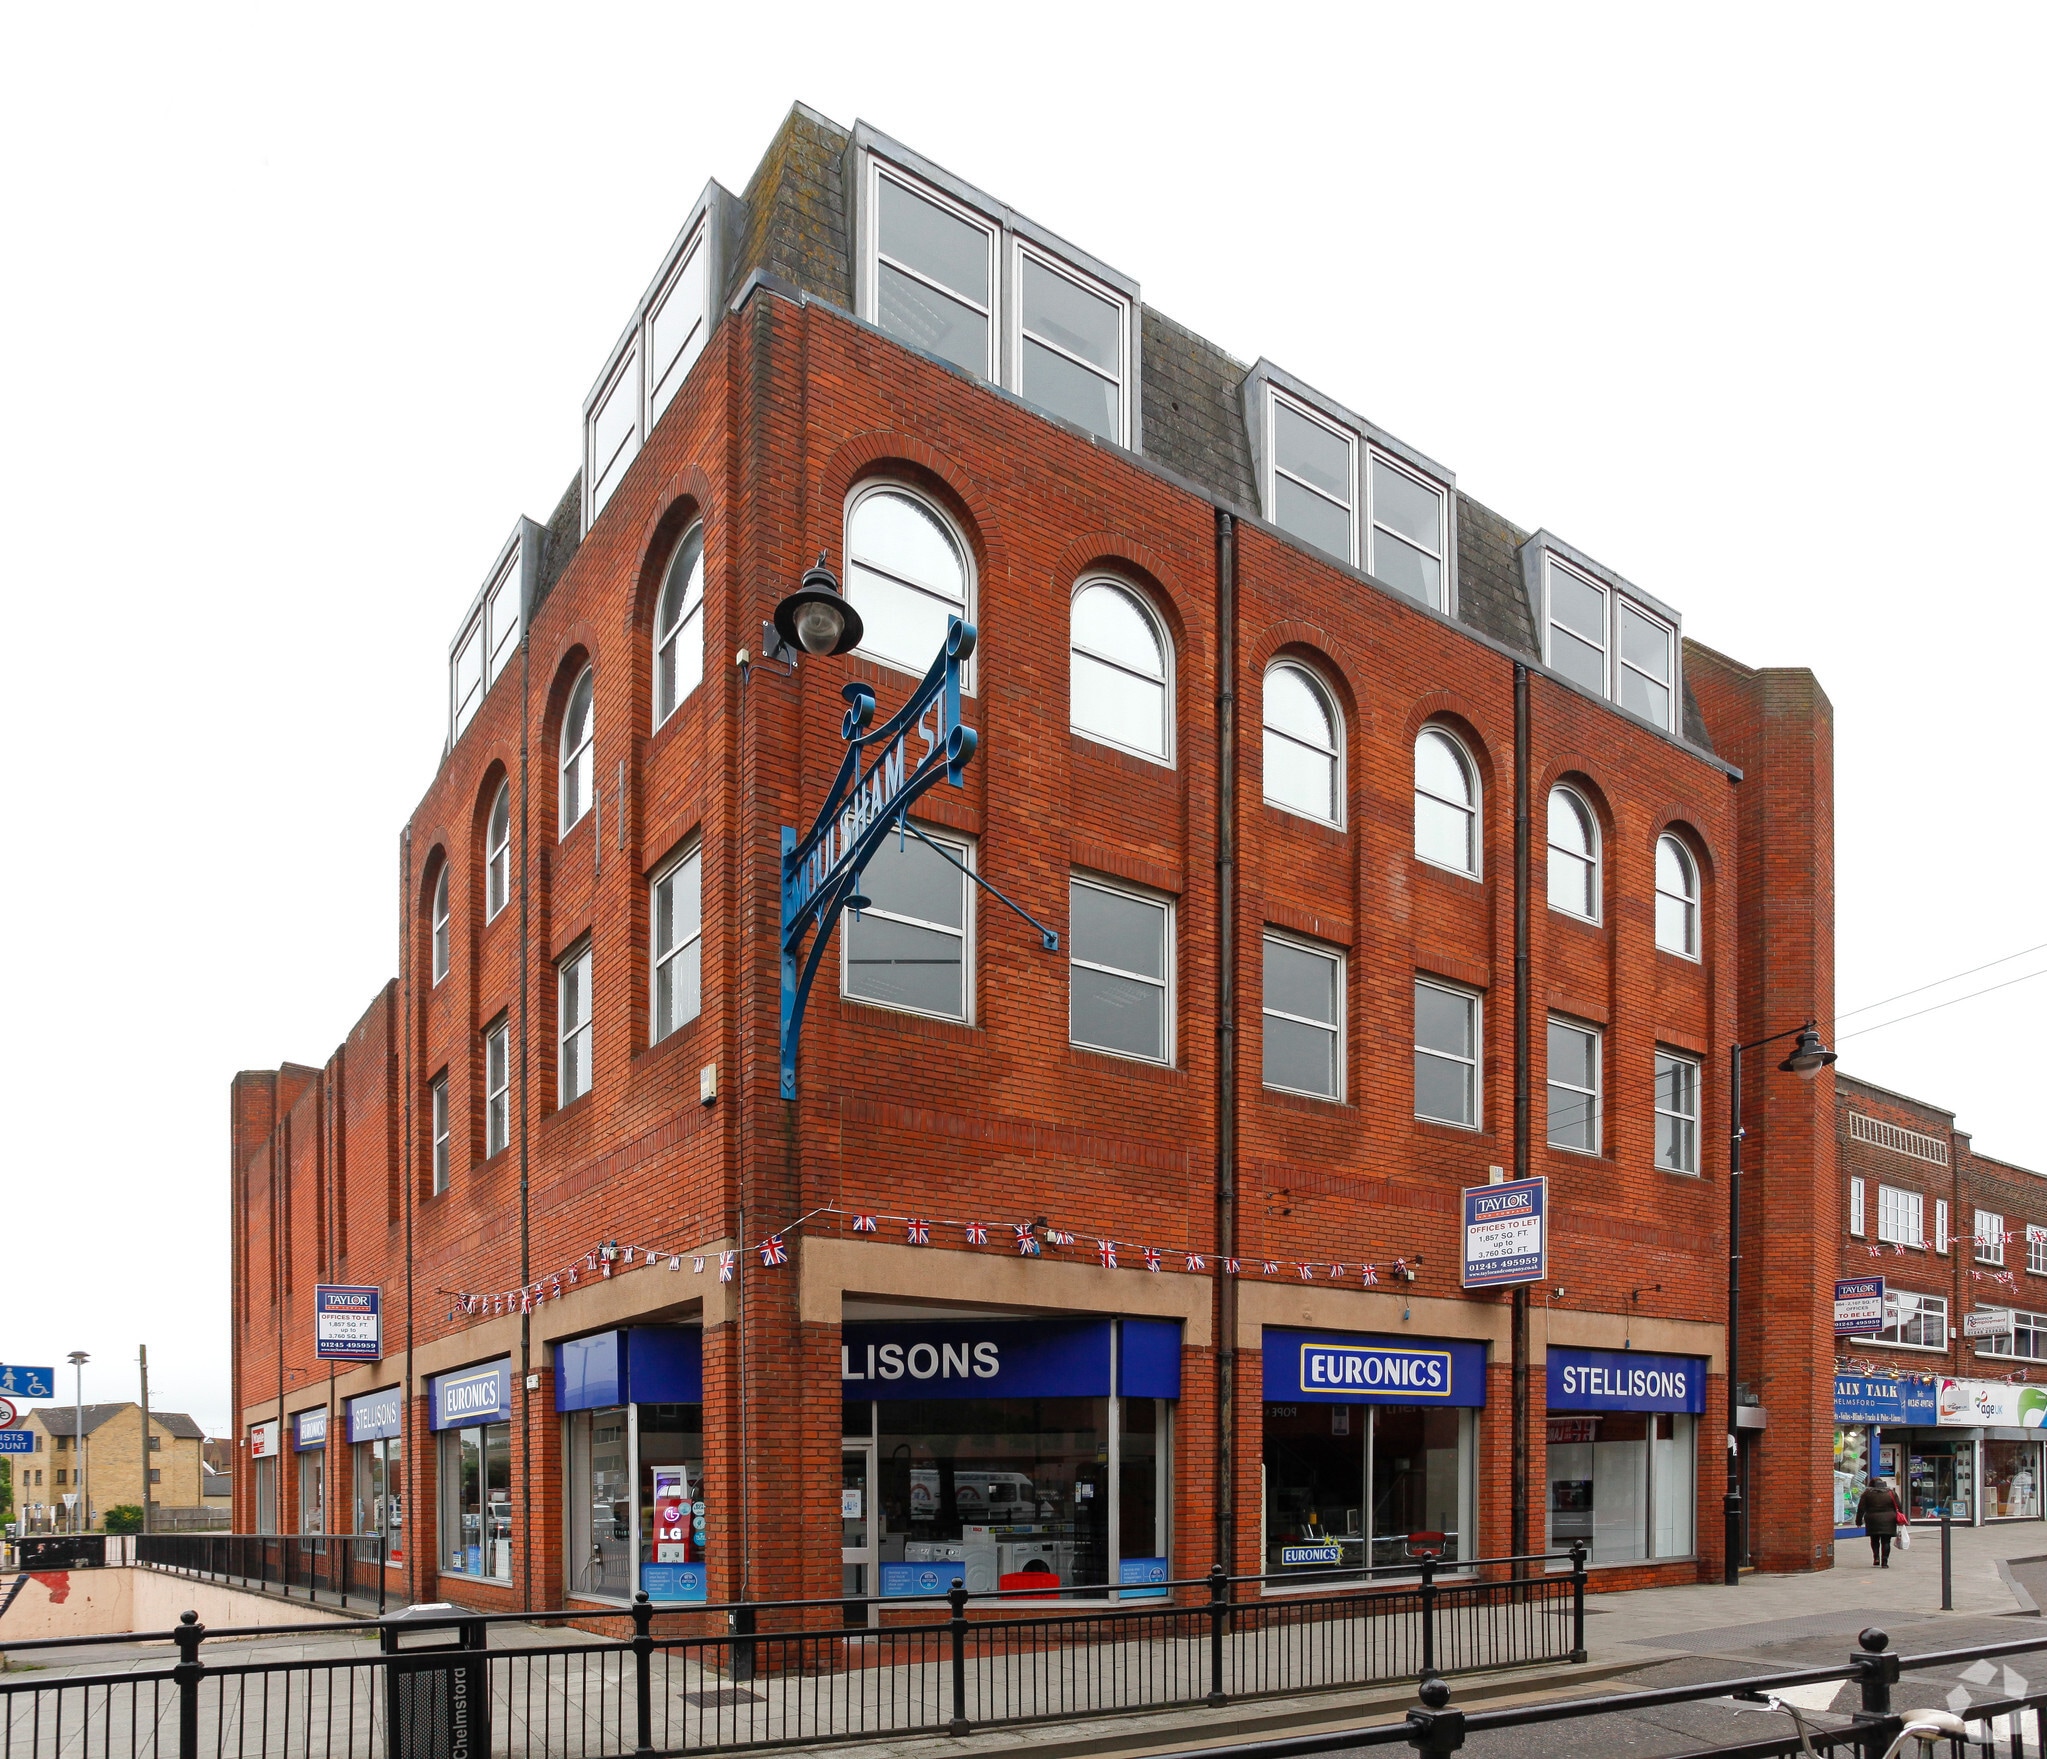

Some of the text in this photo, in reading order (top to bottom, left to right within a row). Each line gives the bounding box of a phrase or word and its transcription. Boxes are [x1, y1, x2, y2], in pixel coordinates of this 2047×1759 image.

[791, 734, 904, 912] MOULSHAM
[1478, 1193, 1529, 1212] TAYLOR
[1470, 1218, 1537, 1234] OFFICES TO LET
[1479, 1234, 1499, 1242] 1,857
[1517, 1229, 1528, 1237] FT.
[1478, 1251, 1499, 1259] 3,760
[1501, 1248, 1515, 1256] SQ.
[1469, 1256, 1538, 1272] 01245 495959
[1841, 1284, 1874, 1294] TAYLOR
[328, 1295, 368, 1305] TAYLOR
[841, 1342, 1000, 1380] LISONS
[1311, 1354, 1442, 1388] EURONICS
[1563, 1365, 1686, 1398] STELLISONS
[447, 1380, 496, 1412] EURONICS
[1834, 1382, 1898, 1398] AIN TALK
[356, 1402, 396, 1430] STELLISONS
[1981, 1405, 2003, 1418] age UK
[302, 1420, 324, 1440] EURONICS
[660, 1528, 682, 1539] LG
[1285, 1549, 1336, 1561] EURONICS
